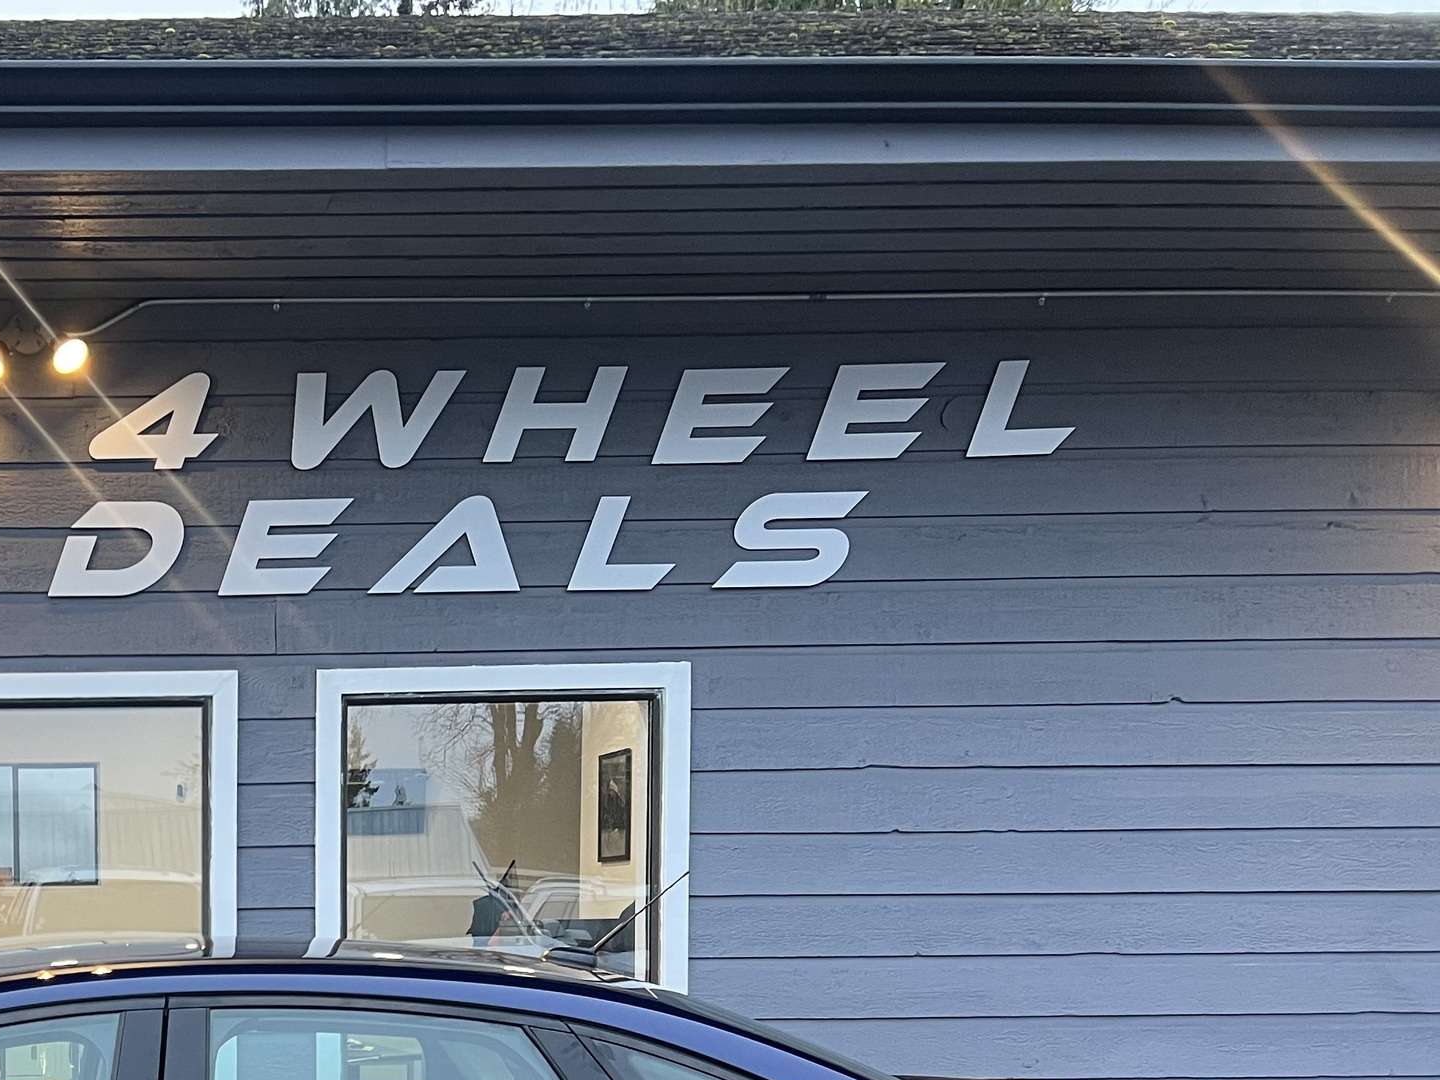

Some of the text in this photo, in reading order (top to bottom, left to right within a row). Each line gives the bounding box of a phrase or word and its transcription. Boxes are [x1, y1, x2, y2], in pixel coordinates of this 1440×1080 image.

[87, 359, 1077, 471] 4 WHEEL
[46, 490, 871, 598] DEALS
